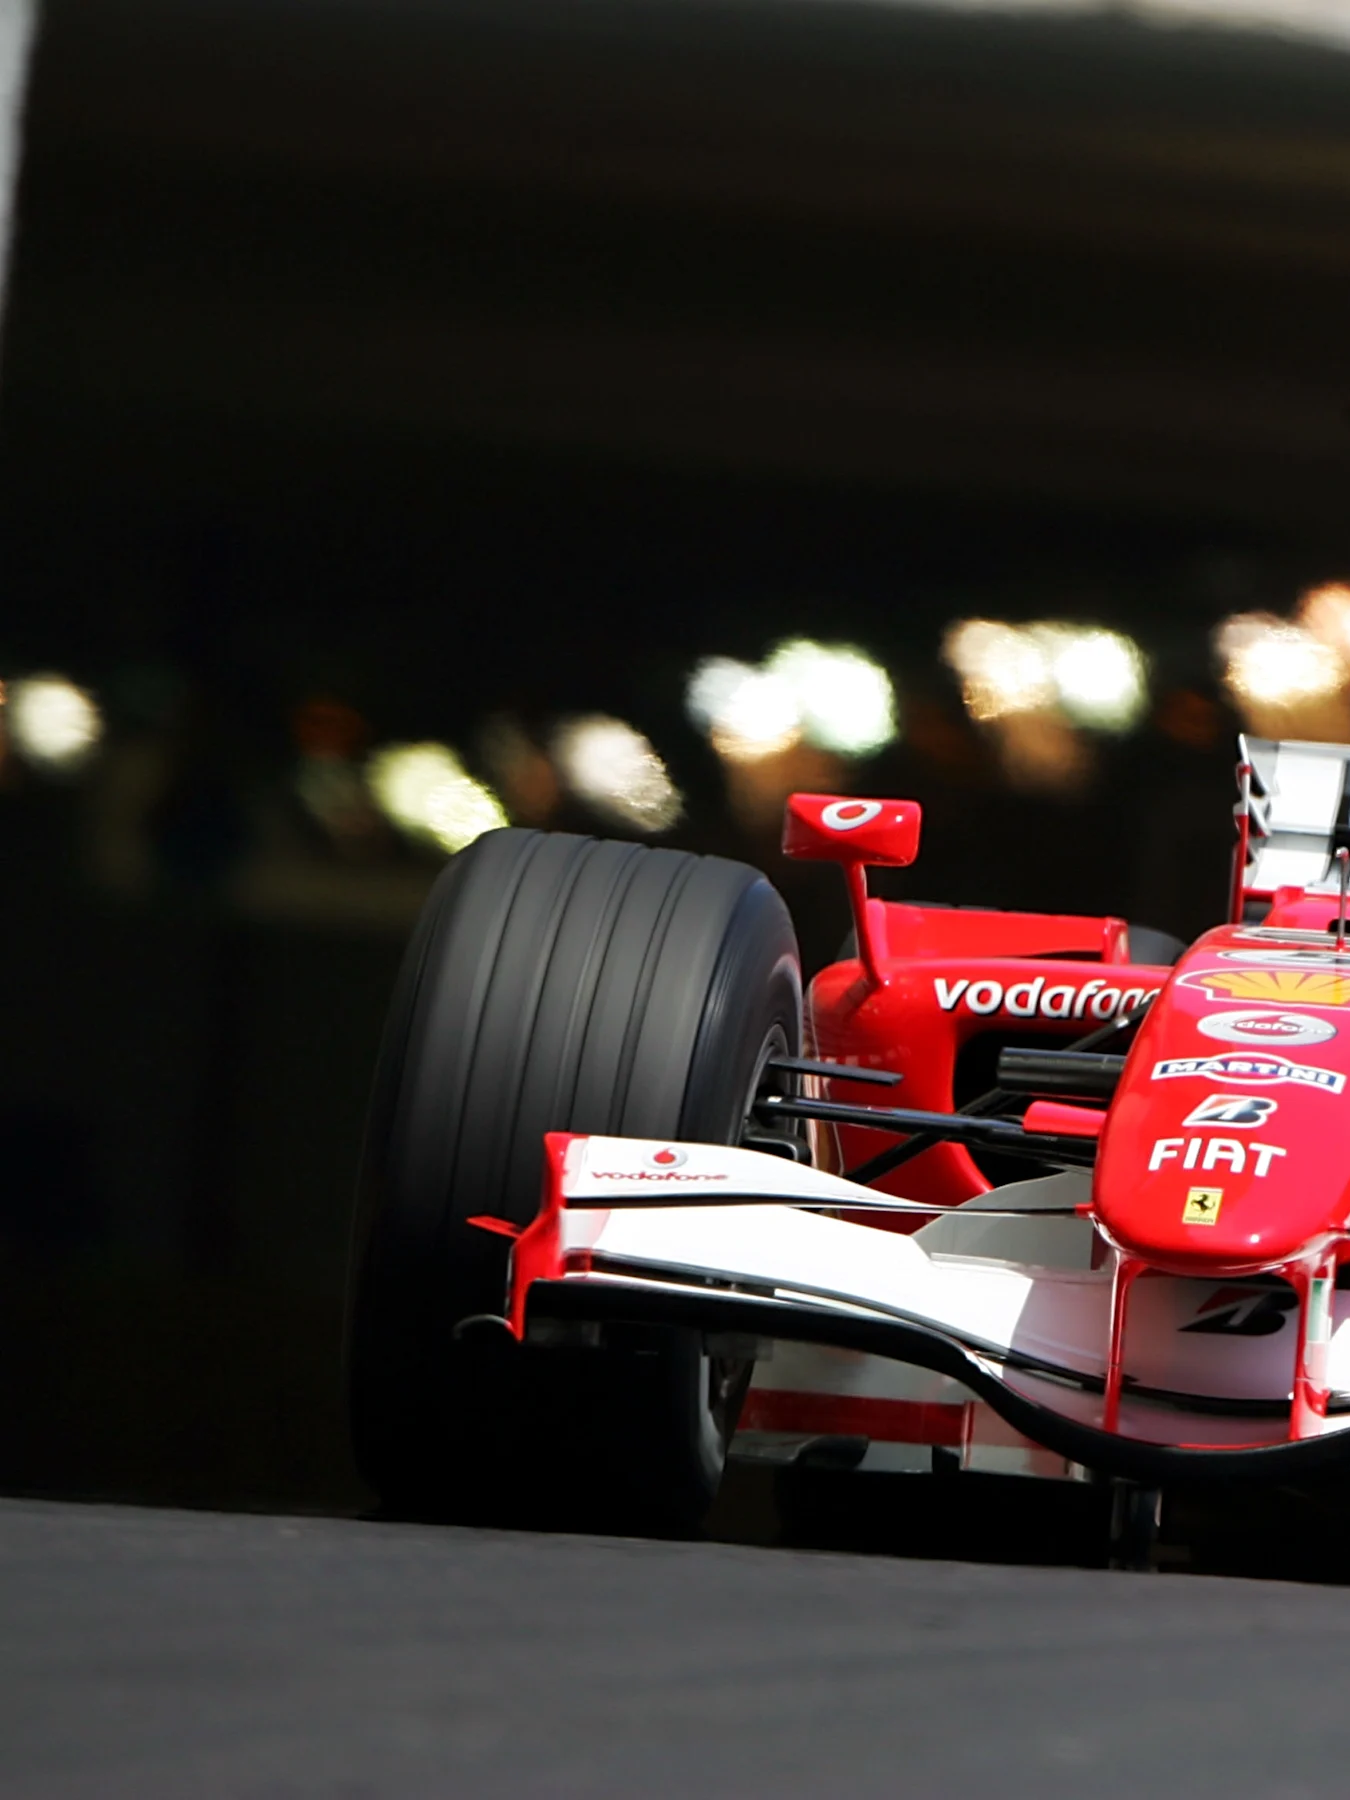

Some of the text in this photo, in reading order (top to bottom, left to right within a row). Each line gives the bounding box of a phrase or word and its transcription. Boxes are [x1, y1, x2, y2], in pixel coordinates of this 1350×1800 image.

[1166, 1061, 1332, 1086] MARTINI
[1148, 1138, 1287, 1177] FIAT
[591, 1170, 728, 1182] vodafone
